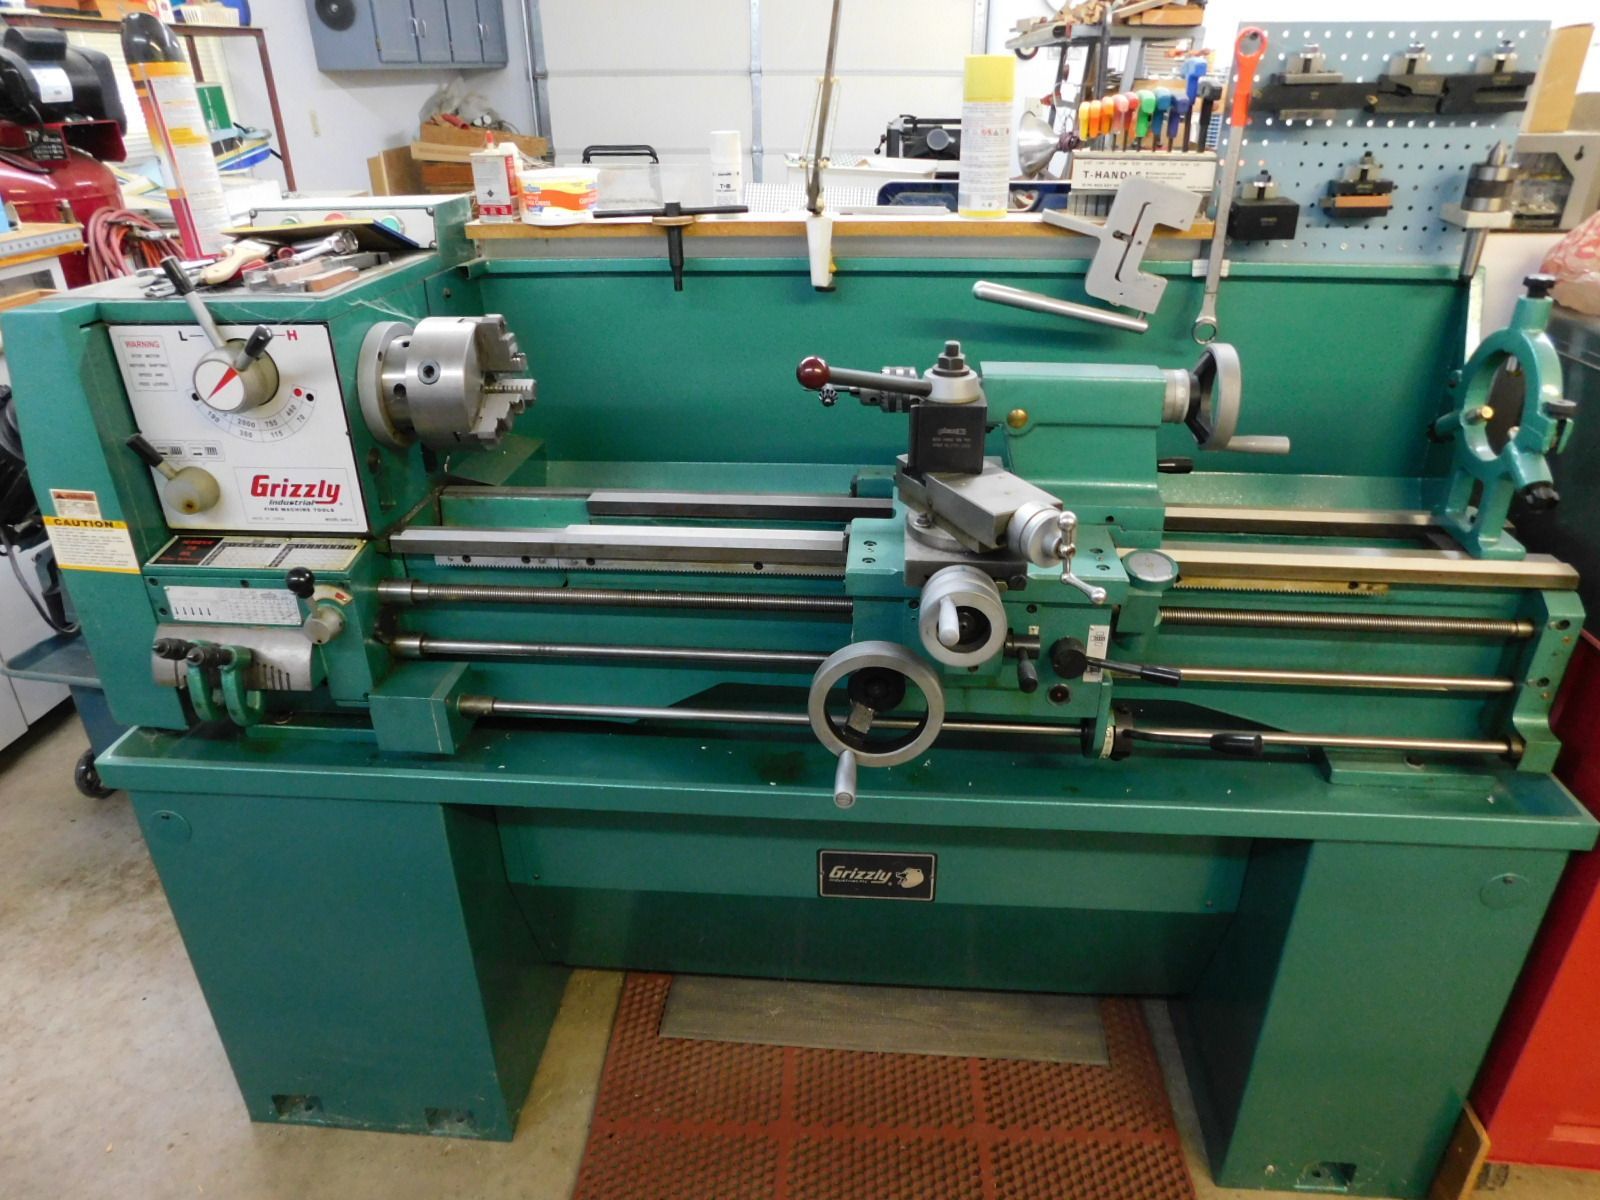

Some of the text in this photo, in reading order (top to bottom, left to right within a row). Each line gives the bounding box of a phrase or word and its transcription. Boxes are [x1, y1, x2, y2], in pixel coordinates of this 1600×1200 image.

[178, 330, 298, 341] L H
[125, 341, 160, 349] WARNING
[208, 411, 220, 423] 190
[296, 414, 306, 423] 70
[237, 418, 256, 428] 2000
[270, 430, 284, 438] 115
[250, 474, 341, 504] Grizzly
[54, 518, 114, 528] CAUTION
[828, 865, 892, 884] Grizzly
